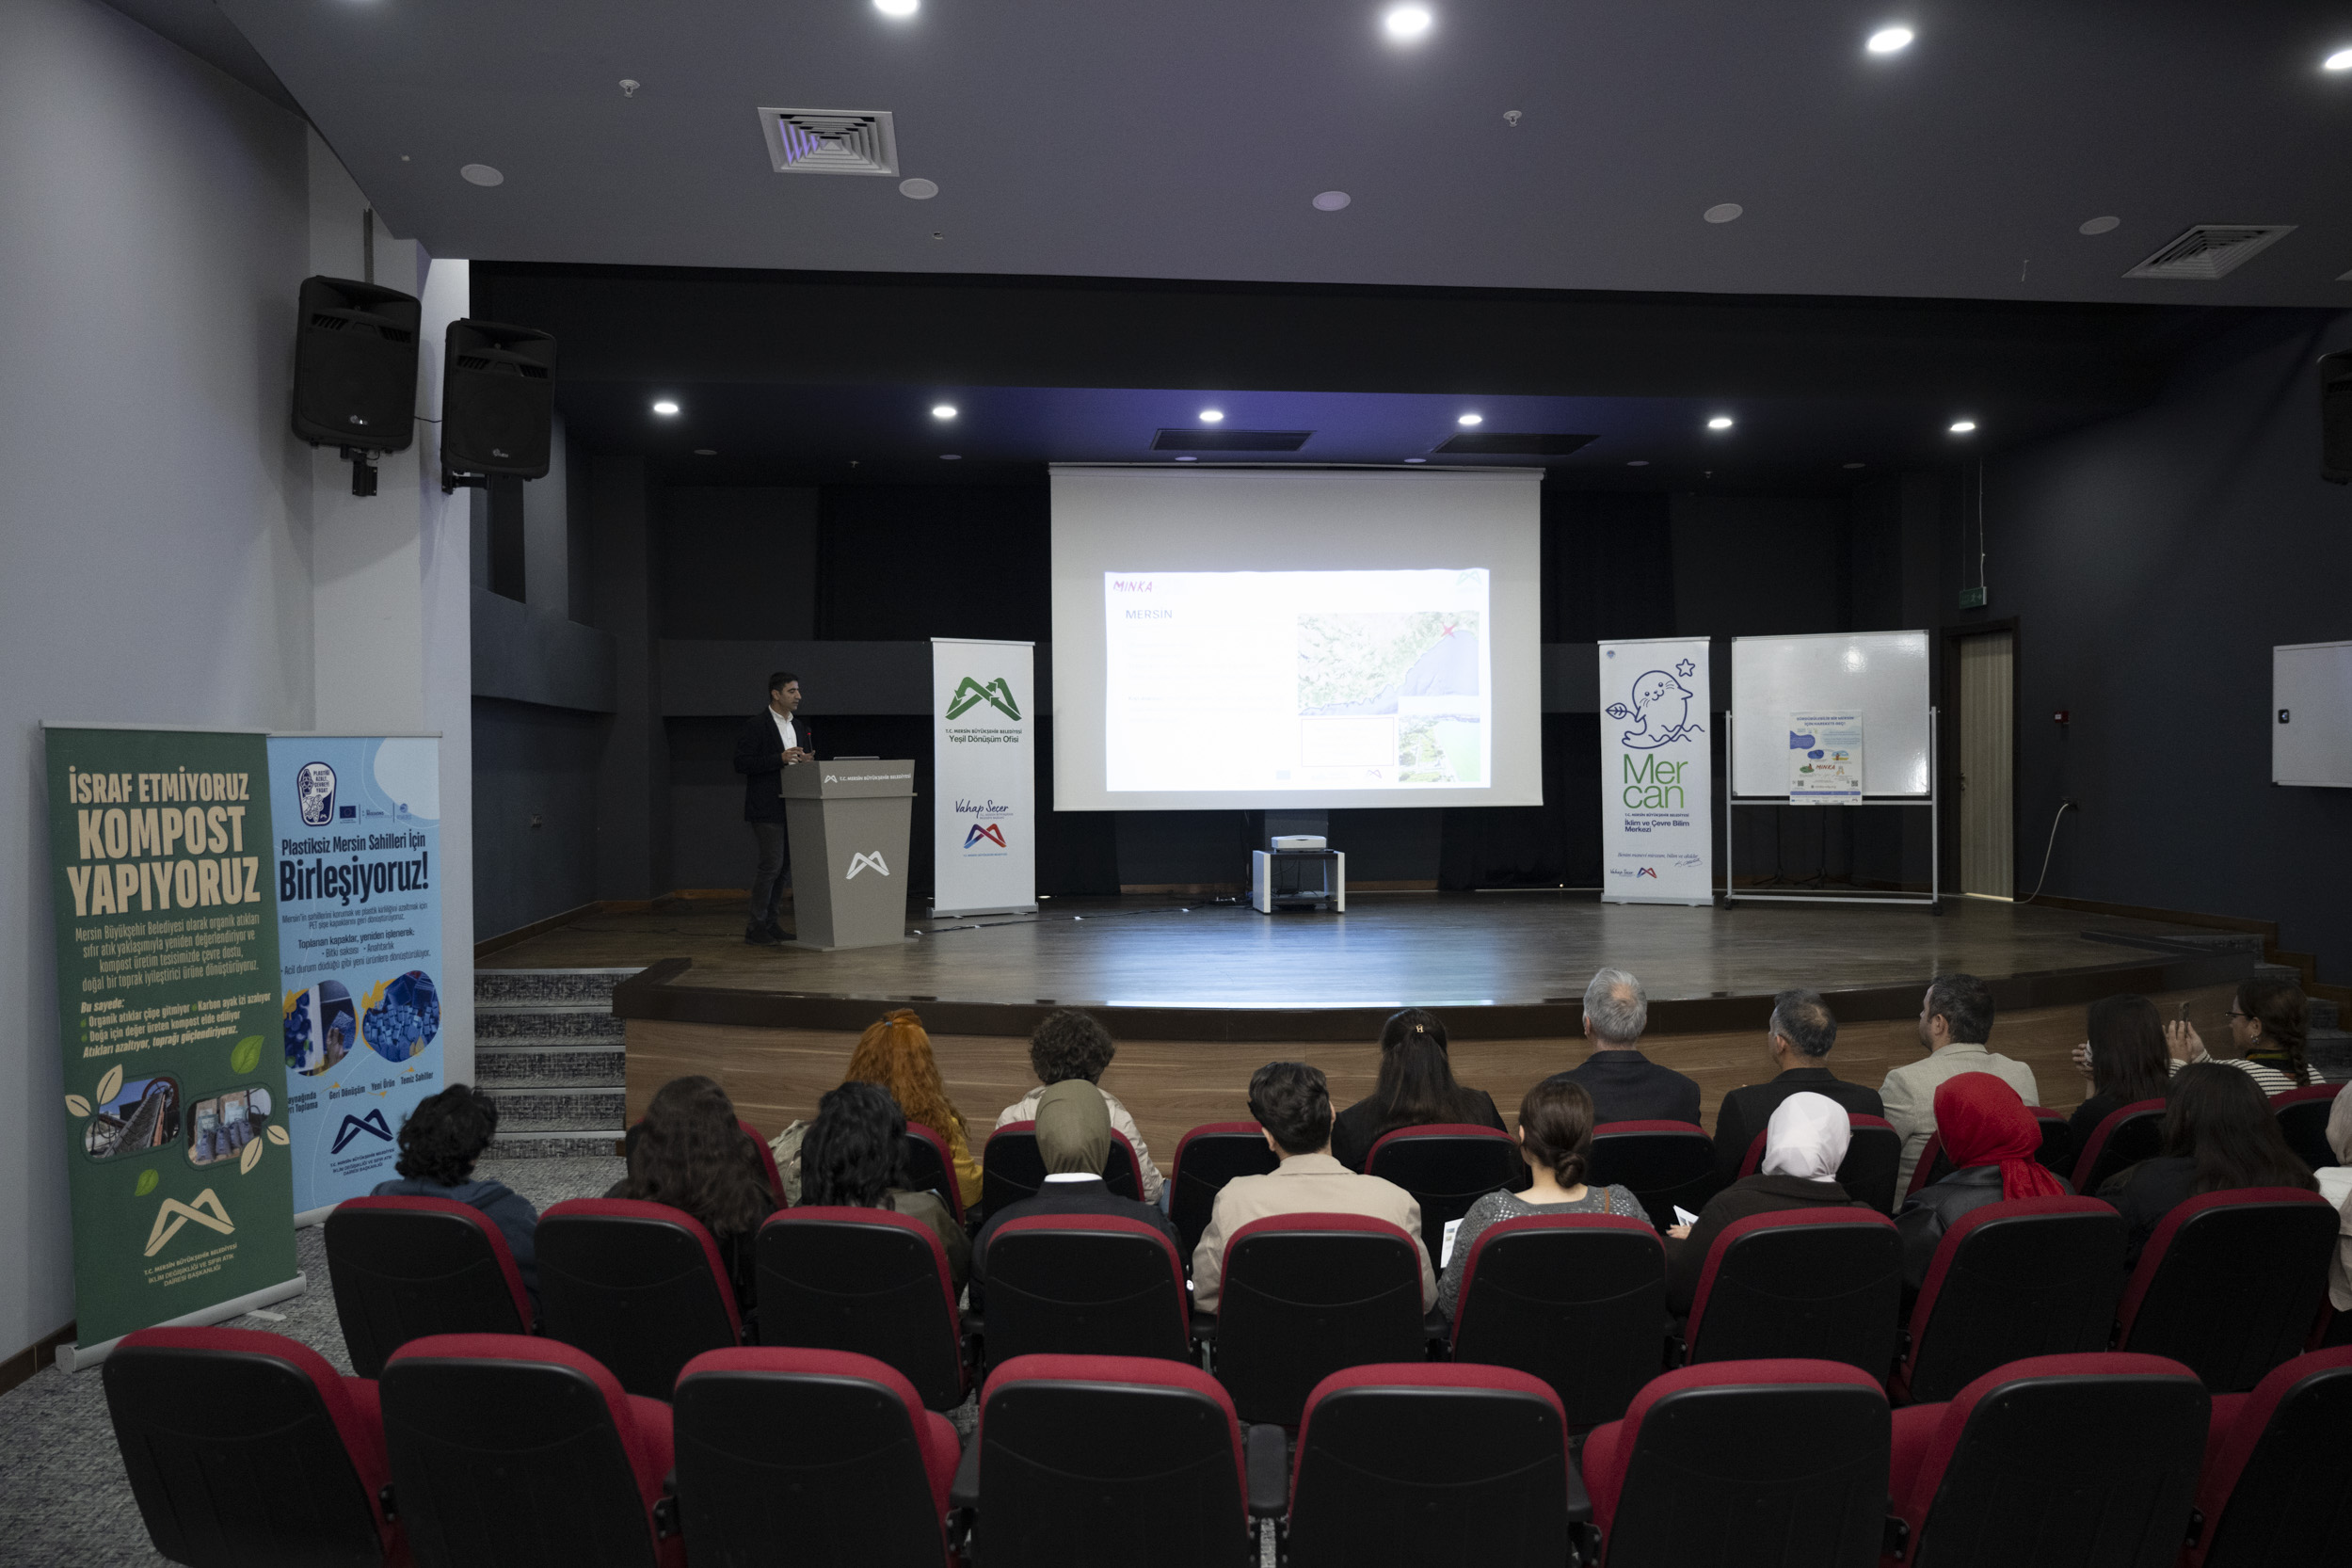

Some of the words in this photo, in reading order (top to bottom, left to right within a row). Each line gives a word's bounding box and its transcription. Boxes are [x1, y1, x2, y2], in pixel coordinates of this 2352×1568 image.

[1113, 580, 1153, 592] MINKA
[949, 735, 966, 744] Yeşil
[968, 735, 1001, 744] Dönüşüm
[1624, 754, 1688, 784] Mer
[69, 766, 132, 804] İSRAF
[139, 766, 249, 802] ETMİYORUZ
[1623, 785, 1684, 809] can
[956, 799, 984, 819] Vahap
[78, 806, 245, 859] KOMPOST
[282, 837, 330, 855] Plastiksiz
[333, 835, 366, 852] Mersin
[369, 832, 406, 850] Sahilleri
[409, 829, 425, 851] İçin
[67, 856, 261, 917] YAPIYORUZ
[280, 851, 428, 906] Birleşiyoruz!
[307, 911, 332, 921] sahillerini
[333, 909, 354, 918] korumak
[362, 907, 376, 917] plastik
[378, 904, 397, 915] kirliliğini
[398, 903, 418, 912] azaltmak
[419, 901, 428, 911] için
[309, 921, 317, 929] PET
[318, 919, 329, 929] şişe
[330, 916, 356, 927] kapaklarını
[357, 916, 366, 925] geri
[76, 927, 102, 941] Mersin
[104, 923, 146, 941] Büyükşehir
[147, 919, 184, 936] Belediyesi
[186, 916, 208, 931] olarak
[210, 914, 235, 930] organik
[237, 913, 259, 926] atıkları
[298, 938, 328, 950] Toplanan
[330, 935, 359, 947] kapaklar,
[360, 931, 384, 943] yeniden
[385, 927, 415, 939] işlenerek:
[83, 943, 99, 958] sıfır
[101, 941, 116, 956] atık
[117, 937, 163, 957] yaklaşımıyla
[165, 934, 193, 952] yeniden
[195, 930, 246, 947] değerlendiriyor
[247, 930, 255, 940] ve
[326, 947, 338, 958] Bitki
[340, 946, 359, 956] saksısı
[367, 941, 394, 952] Anahtarlık
[100, 957, 132, 974] kompost
[134, 954, 158, 969] üretim
[160, 949, 200, 966] tesisimizde
[202, 948, 221, 963] çevre
[222, 946, 243, 958] dostu,
[285, 964, 295, 975] Acil
[296, 962, 317, 973] durum
[318, 958, 340, 971] düdüğü
[341, 957, 351, 968] gibi
[353, 956, 365, 968] yeni
[366, 953, 389, 964] ürünlere
[82, 976, 104, 993] doğal
[107, 975, 117, 989] bir
[119, 971, 143, 989] toprak
[145, 968, 181, 986] iyileştirici
[183, 965, 204, 979] ürüne
[206, 959, 259, 977] dönüştürüyoruz.
[81, 1001, 92, 1013] Bu
[94, 998, 125, 1013] sayede:
[198, 999, 221, 1011] Karbon
[222, 996, 238, 1009] ayak
[247, 993, 271, 1004] azalıyor
[89, 1013, 117, 1028] Organik
[119, 1010, 142, 1023] atıklar
[144, 1008, 160, 1021] çöpe
[162, 1004, 190, 1019] gitmiyor
[90, 1029, 108, 1043] Doğa
[110, 1027, 123, 1041] için
[125, 1024, 146, 1037] değer
[147, 1021, 169, 1033] üreten
[171, 1016, 199, 1029] kompost
[201, 1014, 215, 1025] elde
[217, 1011, 240, 1022] ediliyor
[83, 1044, 114, 1058] Atıkları
[115, 1039, 150, 1053] azaltıyor,
[153, 1032, 179, 1048] toprağı
[181, 1026, 238, 1044] güçlendiriyoruz.
[371, 1080, 382, 1091] Yeni
[383, 1079, 395, 1088] Ürün
[401, 1075, 415, 1085] Temiz
[416, 1072, 433, 1083] Sahiller
[288, 1091, 317, 1105] aynağında
[329, 1091, 340, 1100] Geri
[341, 1085, 365, 1098] Dönüşüm
[296, 1101, 318, 1113] Toplama
[148, 1273, 165, 1284] İKLİM
[165, 1264, 198, 1279] DEĞİŞİKLİĞİ
[208, 1257, 222, 1265] SIFIR
[222, 1253, 234, 1262] ATIK
[155, 1262, 175, 1273] MERSİN
[176, 1251, 210, 1266] BÜYÜKŞEHİR
[210, 1242, 238, 1256] BELEDİYESİ
[164, 1275, 187, 1287] DAİRESİ
[187, 1264, 221, 1279] BAŞKANLIĞI
